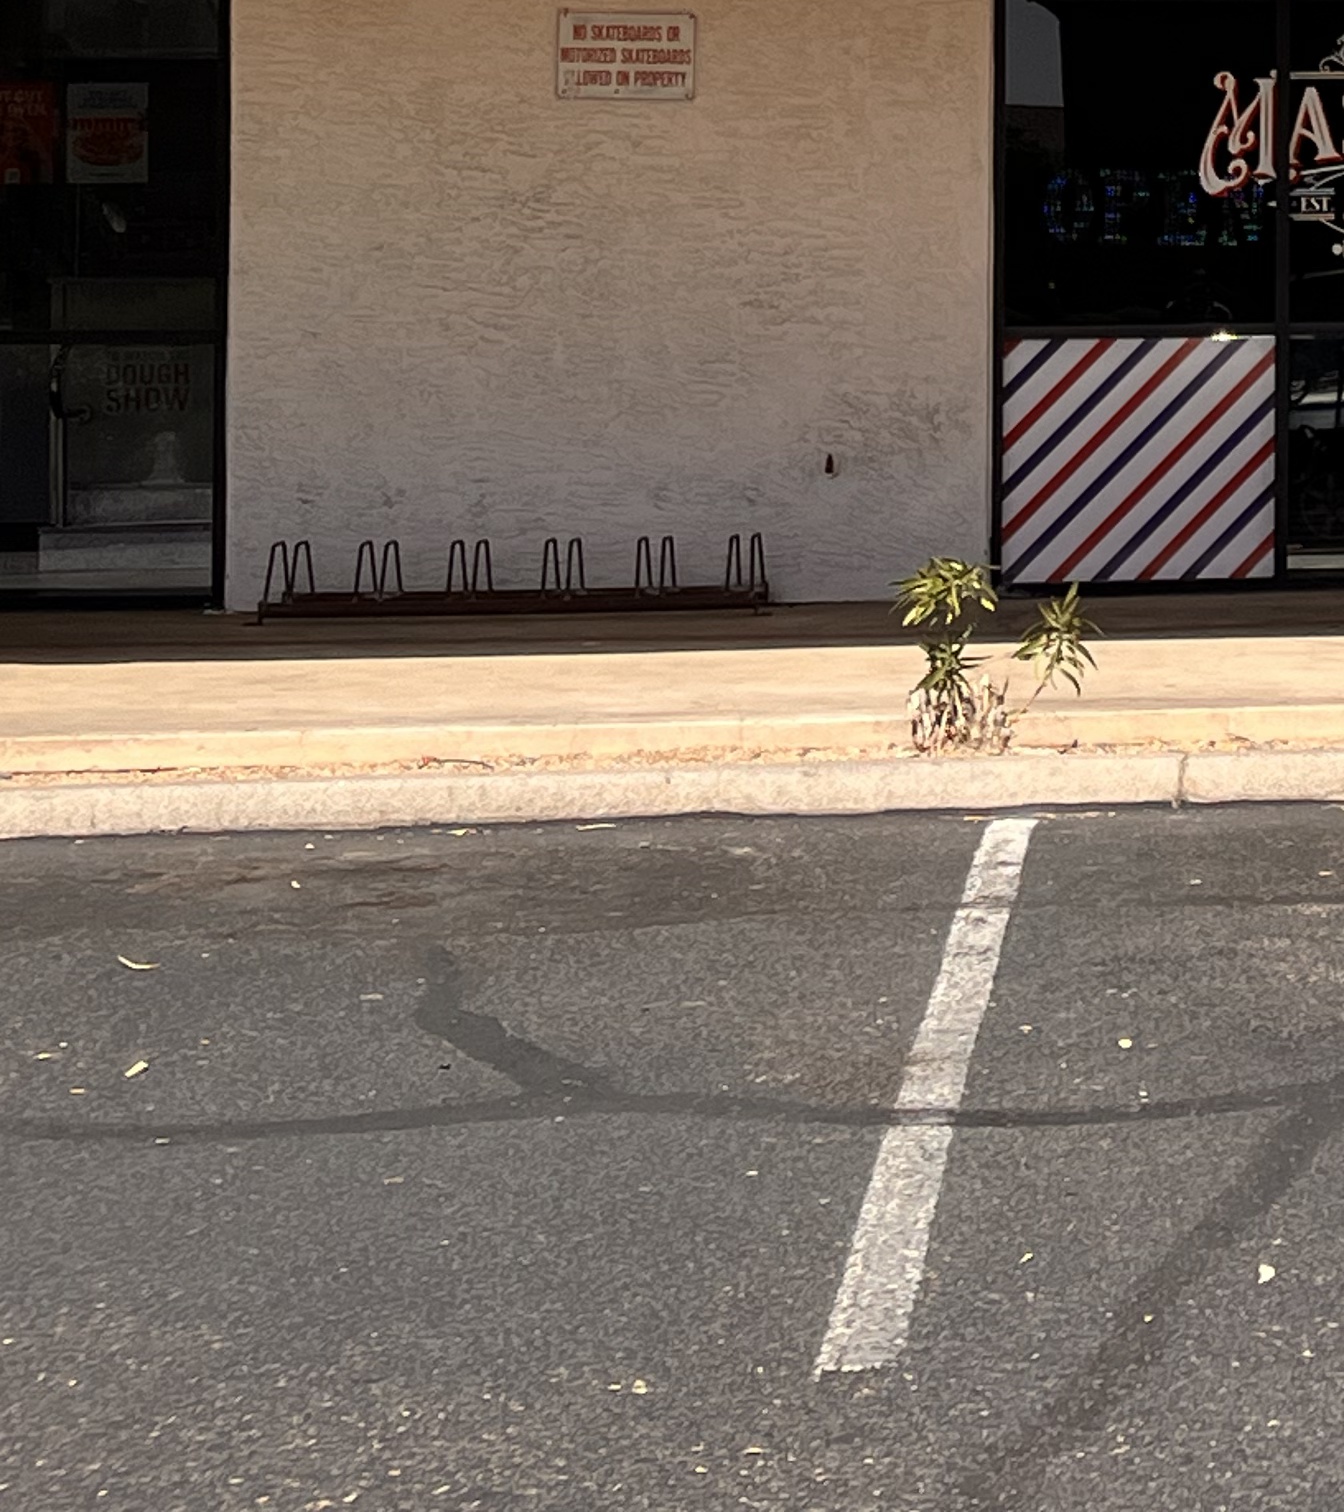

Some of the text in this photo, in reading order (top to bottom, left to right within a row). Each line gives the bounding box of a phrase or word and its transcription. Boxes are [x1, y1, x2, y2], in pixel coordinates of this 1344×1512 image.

[573, 24, 681, 42] NO SKATEBOARDS OR
[560, 46, 692, 65] MOTORIZED SKATEBOARDS
[616, 70, 630, 87] ON
[634, 70, 687, 87] PROPERTY
[104, 363, 191, 385] DOUGH
[105, 387, 190, 412] SHOW
